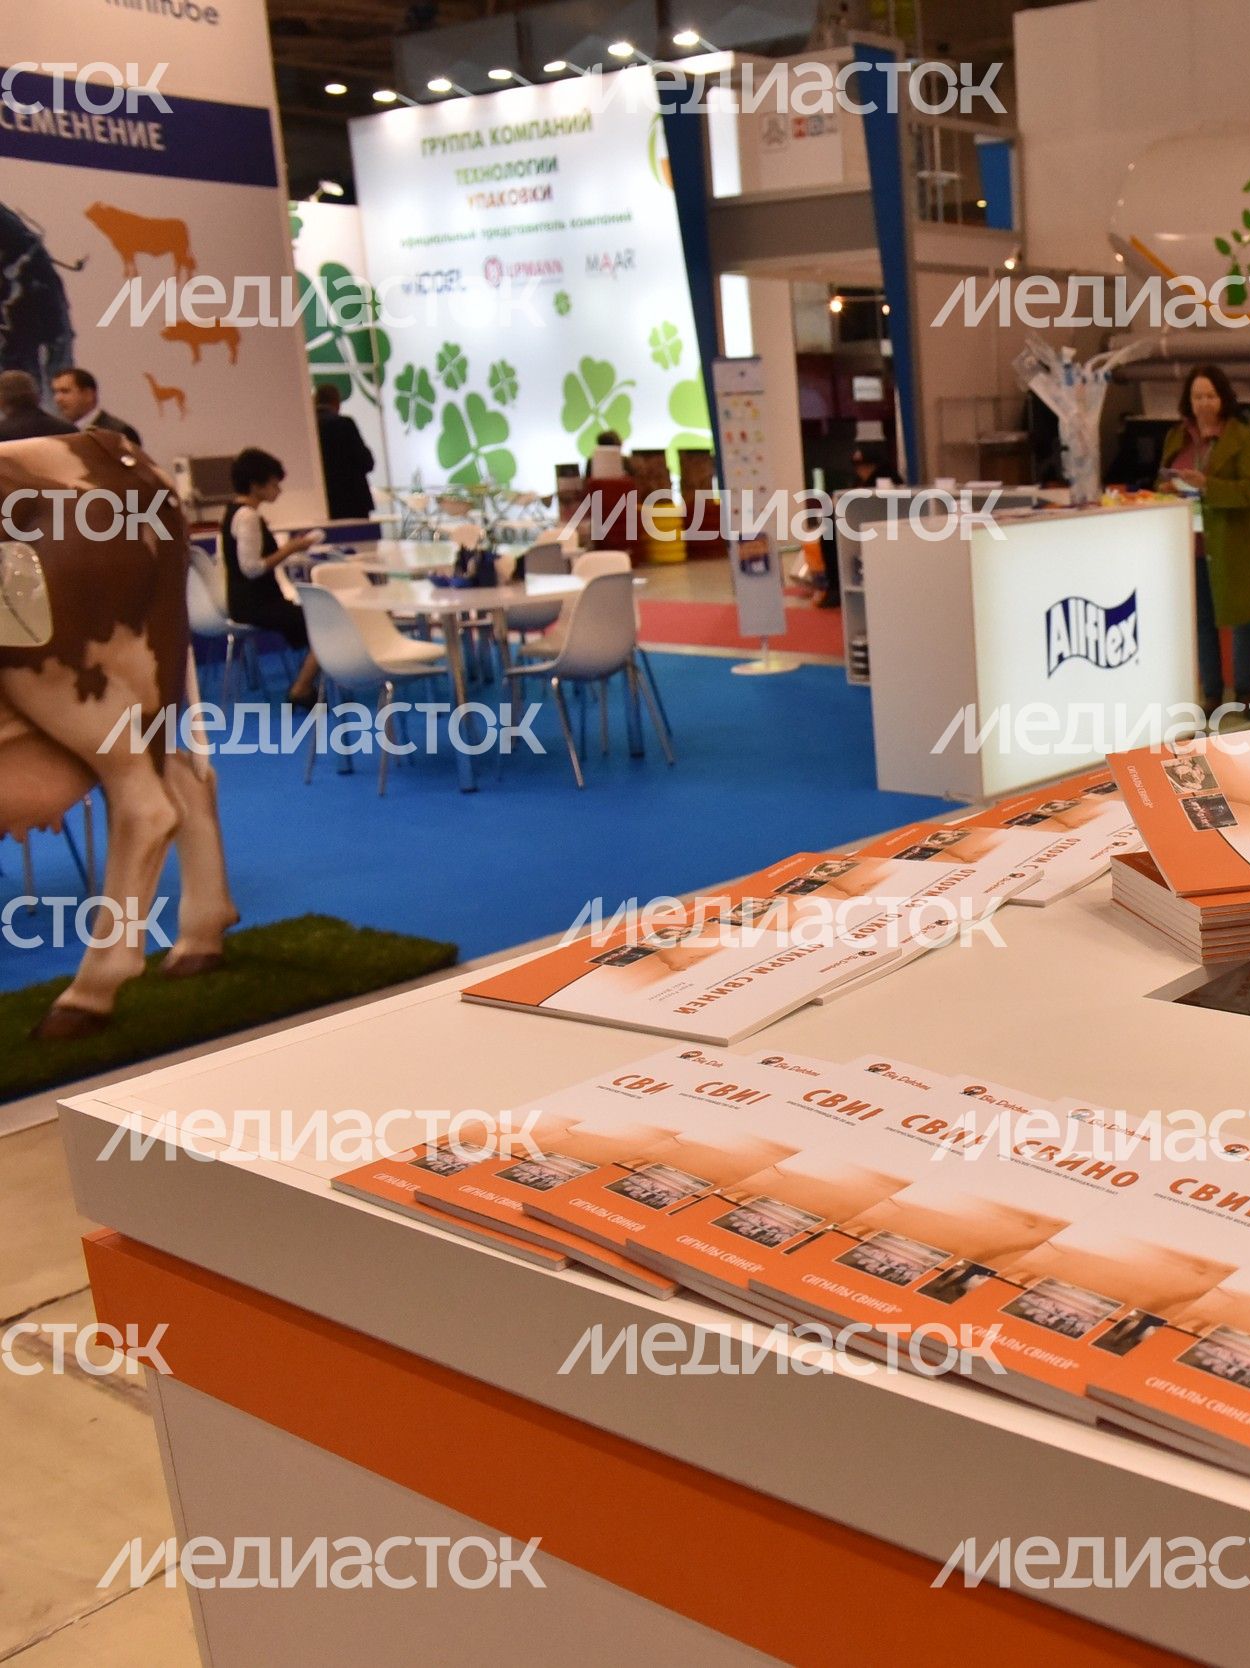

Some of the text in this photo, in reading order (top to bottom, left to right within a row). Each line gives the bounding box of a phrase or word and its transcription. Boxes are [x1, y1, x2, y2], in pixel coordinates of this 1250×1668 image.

[421, 108, 593, 157] ГРУППА КОМПАНИЙ
[455, 155, 559, 185] ТЕХНОЛОГИИ
[466, 184, 554, 209] УПАКОВКИ
[1046, 588, 1139, 678] Allflex
[921, 868, 976, 897] ОТКОРМ
[750, 943, 825, 975] ОТКОРМ
[673, 976, 754, 1015] СВИНЕЙ
[694, 1081, 772, 1106] СВИ
[676, 1234, 723, 1260] СИГНАЛЫ
[801, 1273, 852, 1298] СИГНАЛЫ
[1144, 1376, 1208, 1405] СИГНАЛЫ
